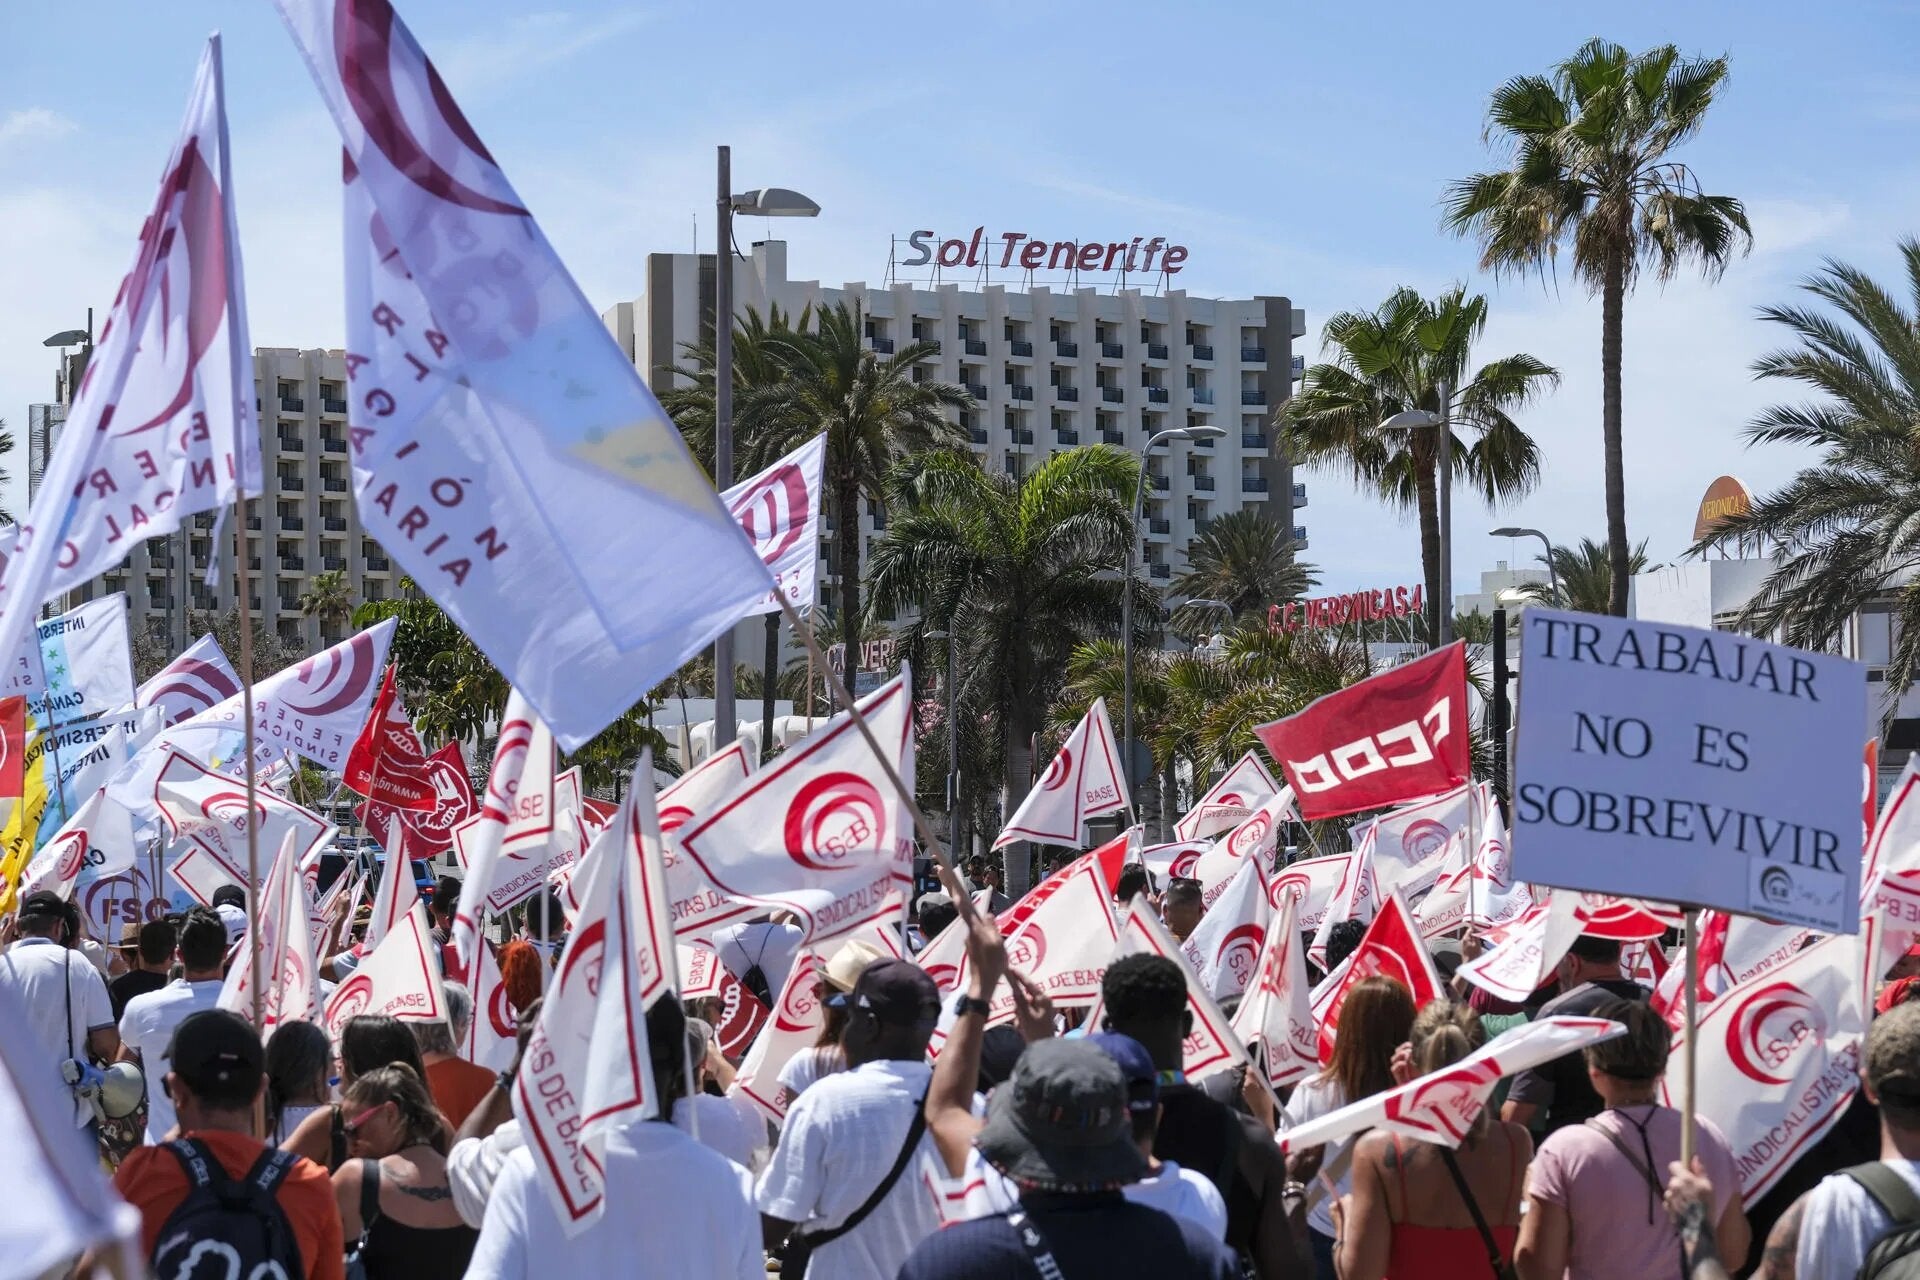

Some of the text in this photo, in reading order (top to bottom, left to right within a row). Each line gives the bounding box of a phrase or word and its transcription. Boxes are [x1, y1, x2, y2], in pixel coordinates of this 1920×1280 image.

[902, 226, 1189, 274] Sol Tenerife
[1411, 584, 1423, 614] 4
[1533, 618, 1821, 702] TRABAJAR
[1572, 712, 1749, 772] NO ES
[358, 770, 421, 800] www.ugtes
[1086, 785, 1114, 803] BASE
[1518, 783, 1845, 874] SOBREVIVIR
[817, 871, 897, 932] SINDICALISTA
[1073, 968, 1106, 987] BAS
